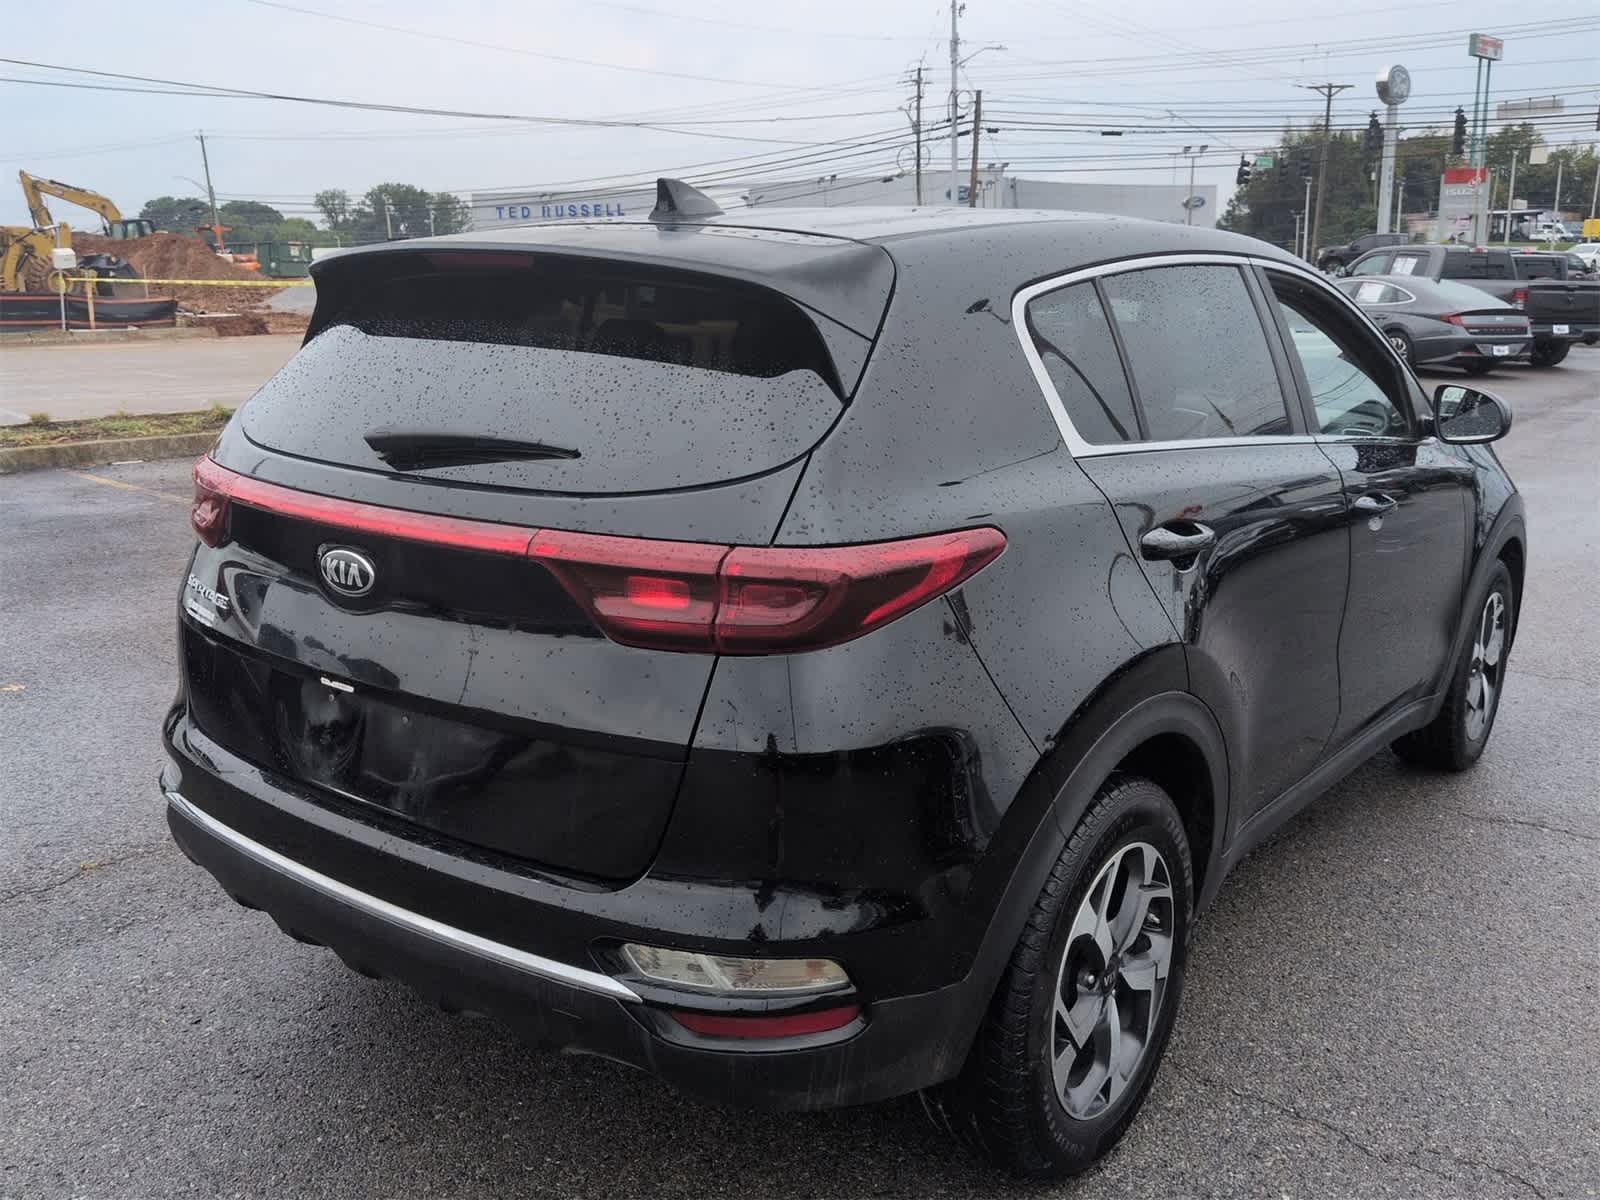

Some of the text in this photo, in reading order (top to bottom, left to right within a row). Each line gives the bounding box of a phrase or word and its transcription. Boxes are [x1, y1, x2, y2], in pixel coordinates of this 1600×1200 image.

[495, 203, 624, 219] TED RUSSELL
[326, 556, 363, 587] KIA
